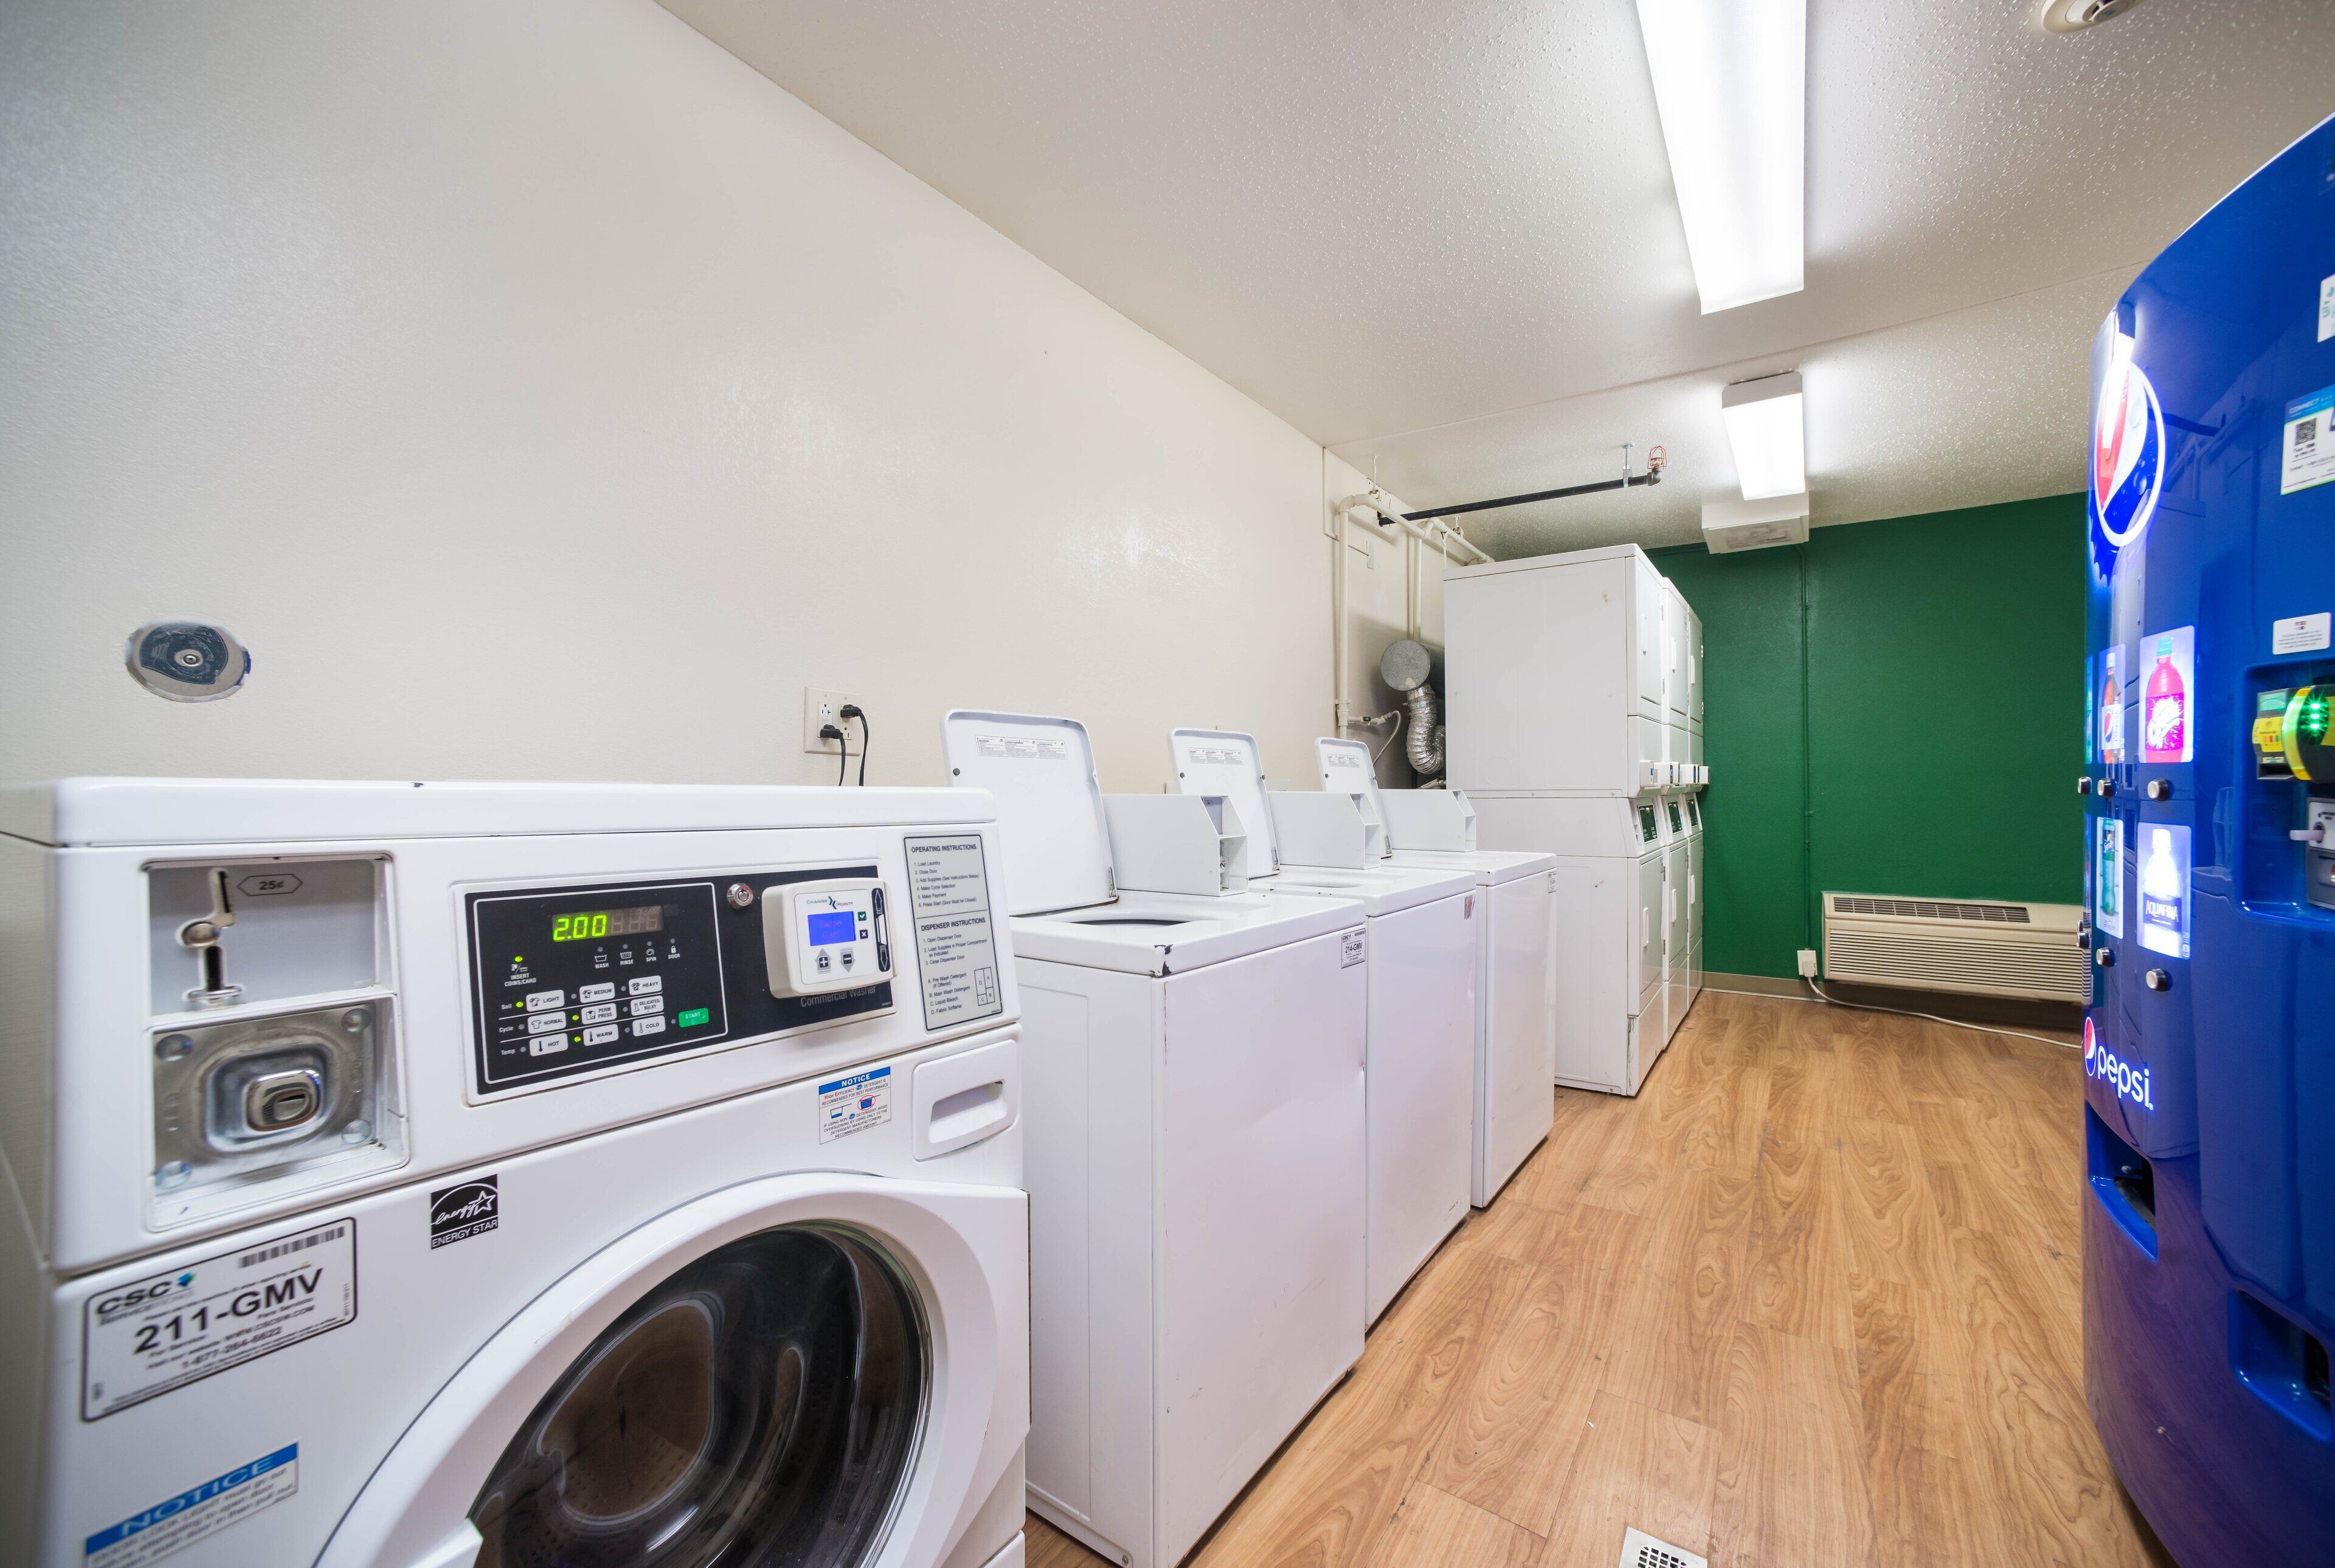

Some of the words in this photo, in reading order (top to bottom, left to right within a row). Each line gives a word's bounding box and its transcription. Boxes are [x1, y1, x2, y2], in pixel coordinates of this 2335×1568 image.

[2145, 900, 2179, 922] AQUAFINA
[553, 914, 607, 941] 2.00
[921, 922, 949, 931] DISPENSER
[951, 917, 985, 927] INSTRUCTIONS
[1345, 942, 1363, 953] 214-GMV
[505, 978, 536, 987] COINS/CARD
[801, 991, 847, 1007] Commercial
[849, 986, 876, 997] Washer
[842, 1074, 870, 1086] NOTICE
[2098, 1046, 2151, 1108] pepsi
[822, 1095, 848, 1105] RECOMMENDED
[865, 1083, 888, 1094] PERFORMANCE
[835, 1088, 854, 1097] EFFICIENCY
[824, 1122, 849, 1132] OVERSUDSING
[831, 1126, 851, 1135] DETERGENT
[853, 1116, 882, 1128] MANUFACTURERS
[835, 1127, 862, 1138] RECOMMENDED
[432, 1228, 471, 1247] ENERGY
[473, 1220, 497, 1234] STAR
[97, 1281, 173, 1314] CSC
[134, 1268, 323, 1355] 211-GMV
[121, 1456, 275, 1537] NOTICE
